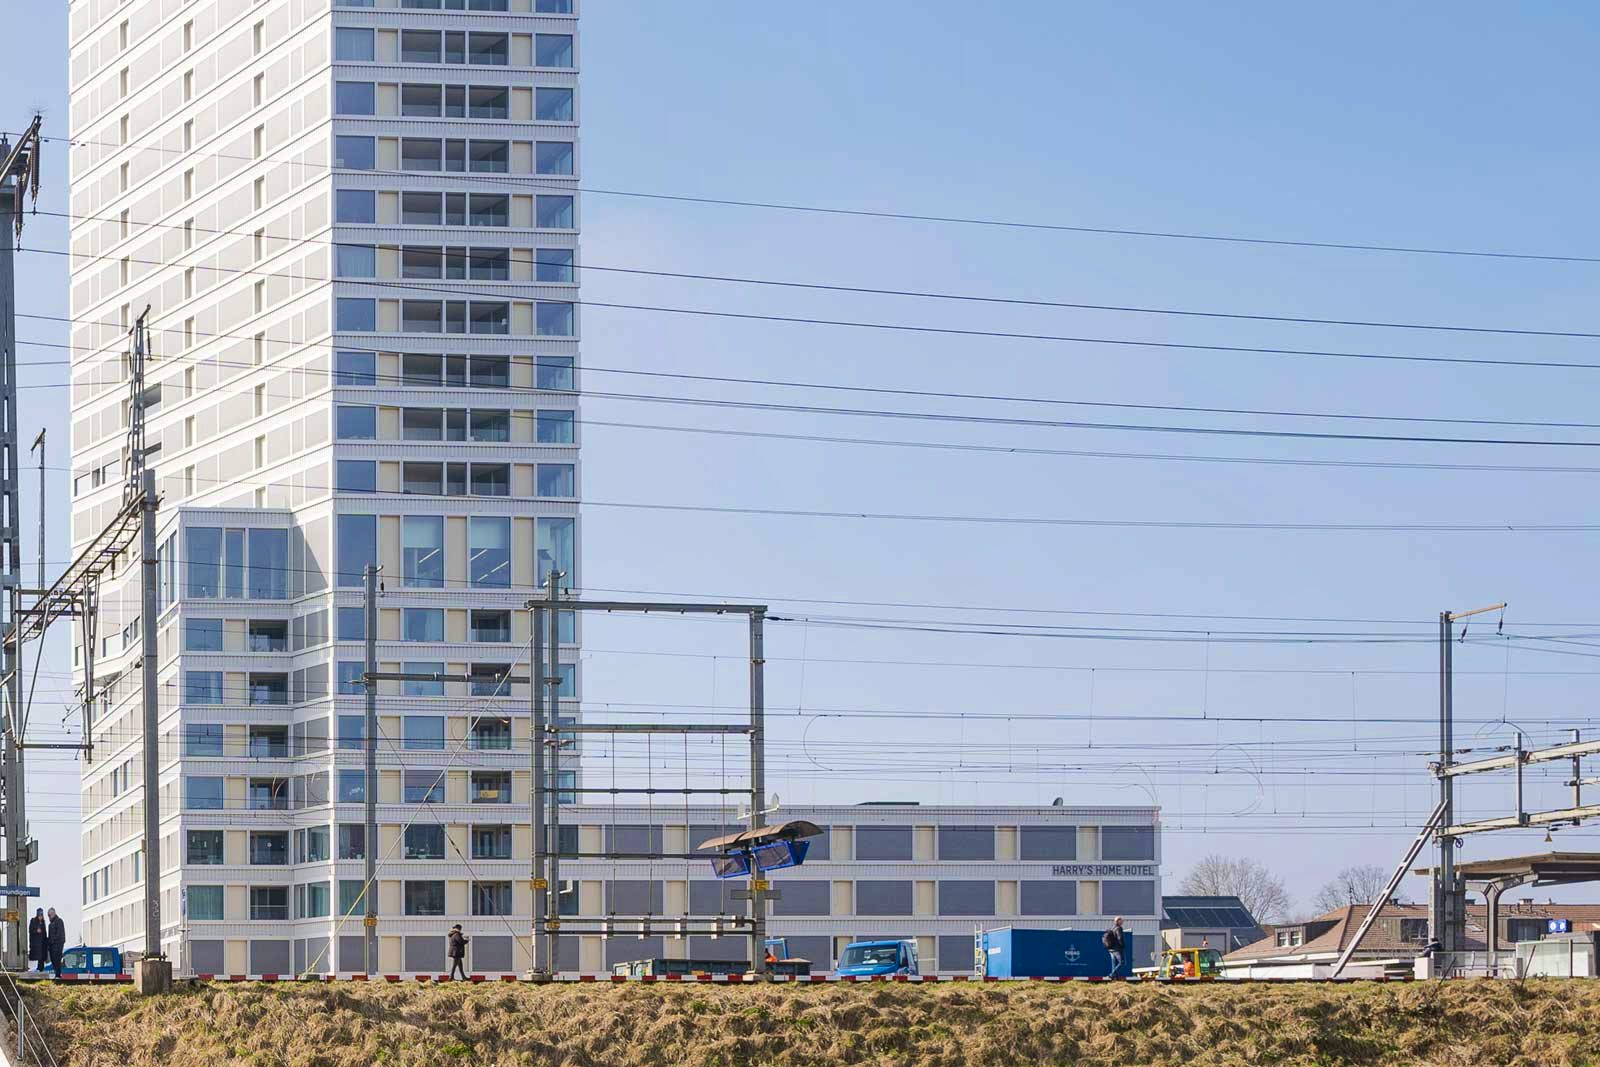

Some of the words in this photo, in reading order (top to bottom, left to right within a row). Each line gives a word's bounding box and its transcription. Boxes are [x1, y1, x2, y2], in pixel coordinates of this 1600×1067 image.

[1053, 865, 1093, 875] HARRY'S
[1095, 865, 1121, 875] HOME
[1124, 865, 1154, 875] HOTEL
